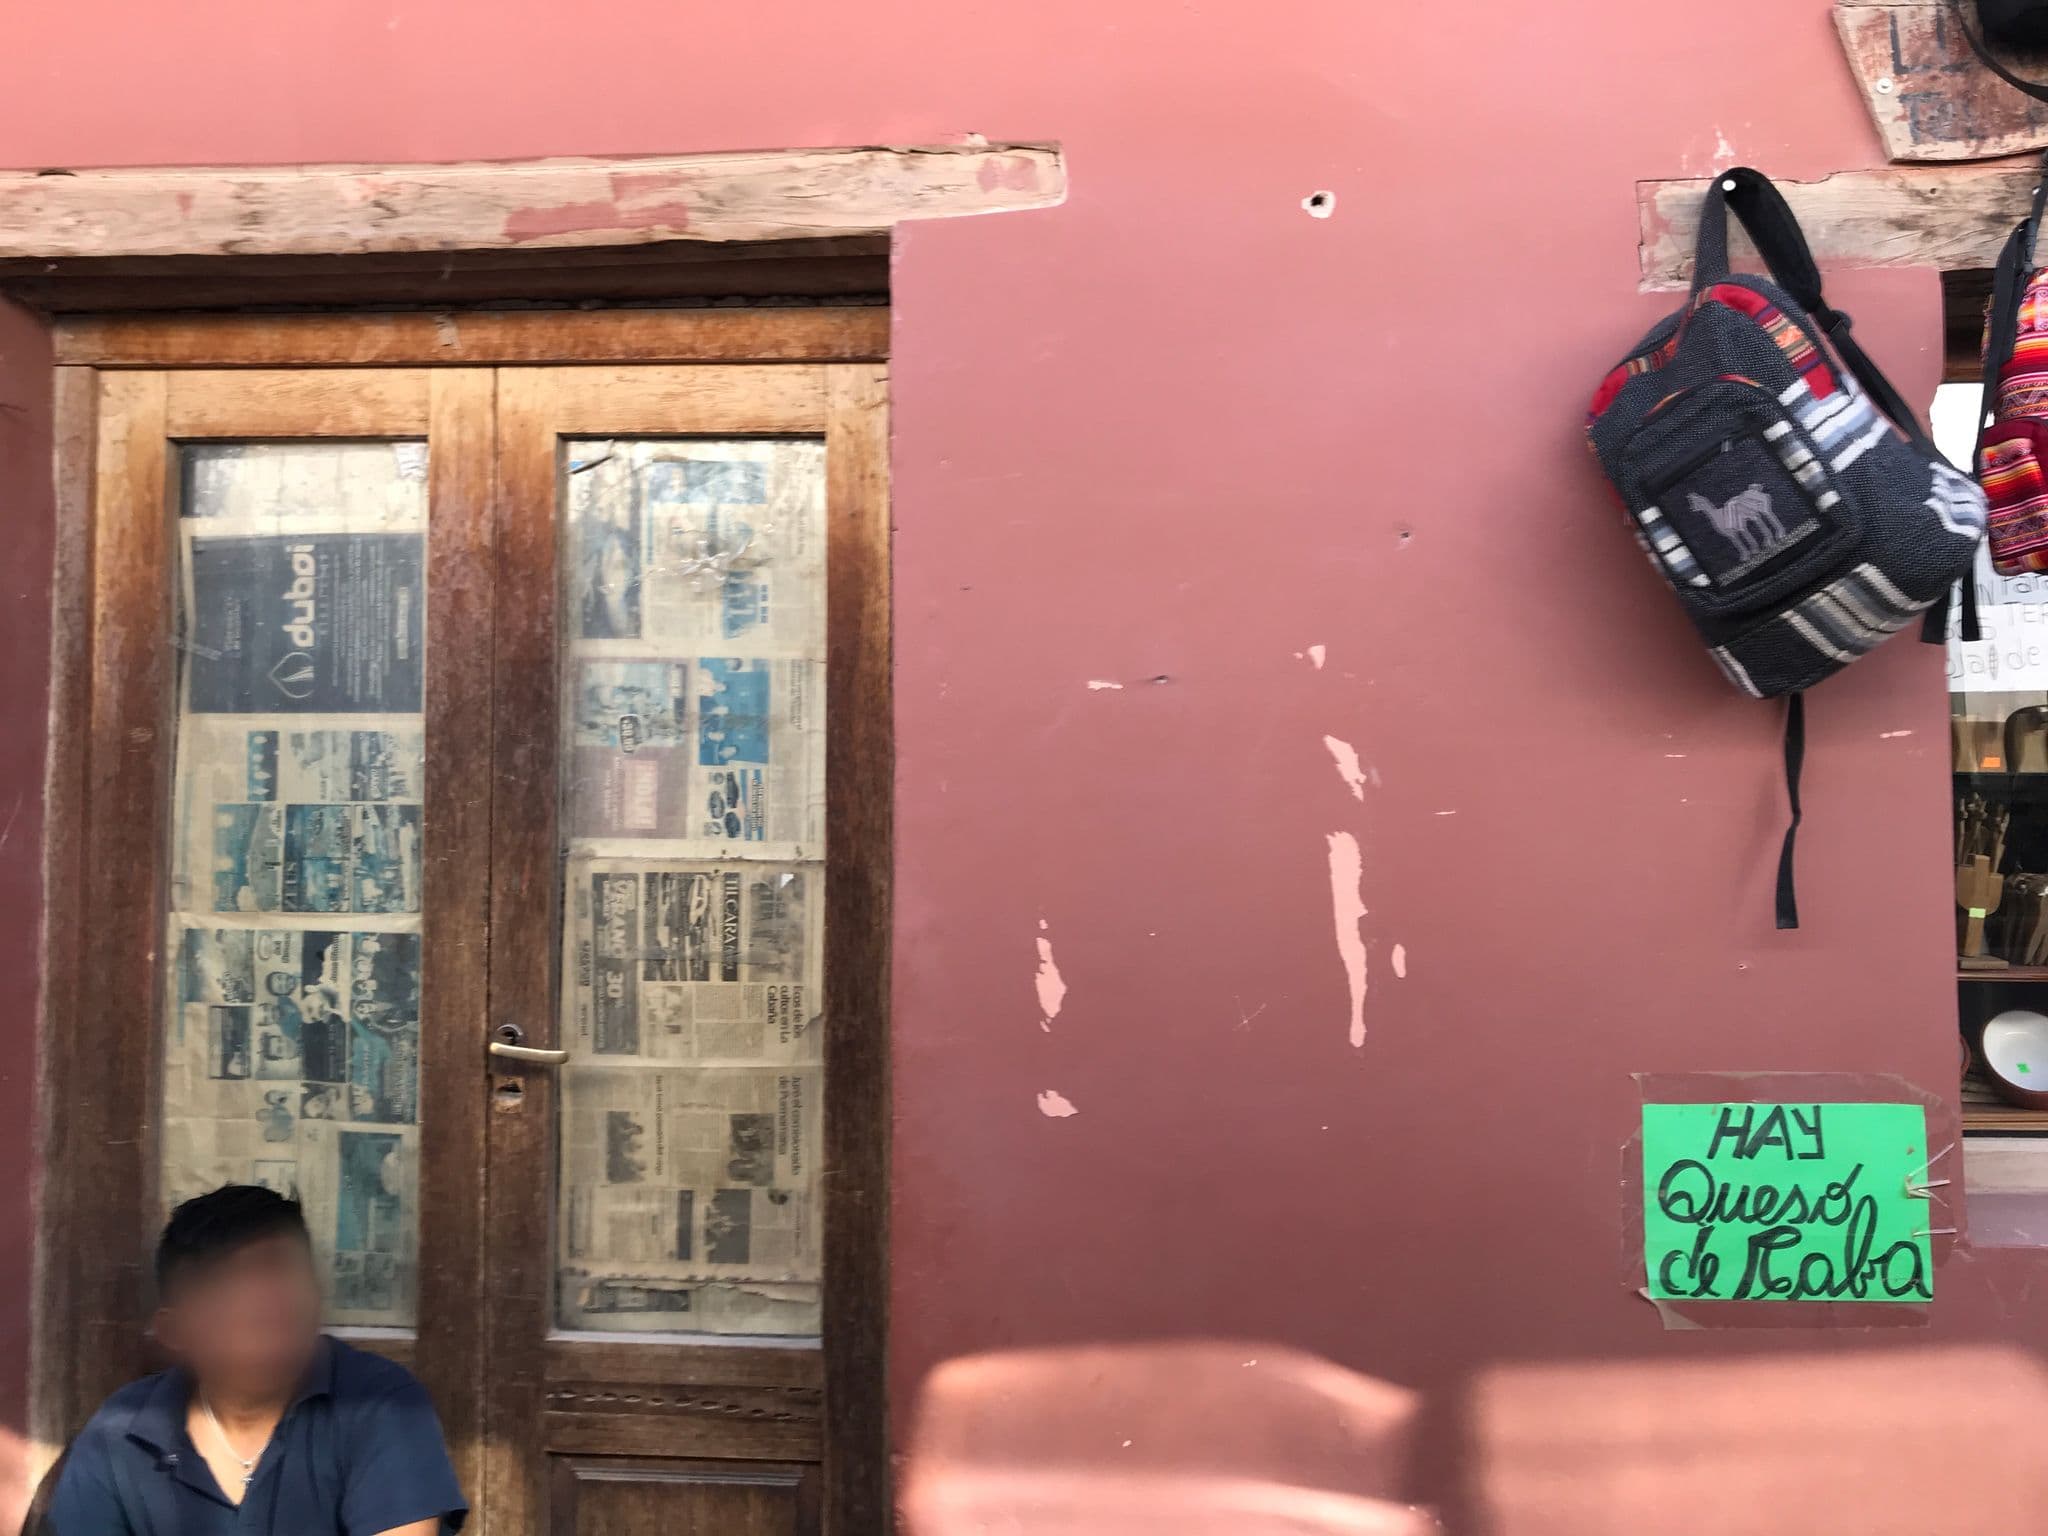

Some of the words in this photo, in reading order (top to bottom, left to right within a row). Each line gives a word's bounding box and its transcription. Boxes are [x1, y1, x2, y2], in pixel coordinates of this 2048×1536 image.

[281, 544, 315, 647] dubai
[767, 985, 779, 1024] Cabaña
[780, 985, 791, 1015] cultos
[1707, 1105, 1825, 1161] HAY
[1659, 1225, 1720, 1297] de
